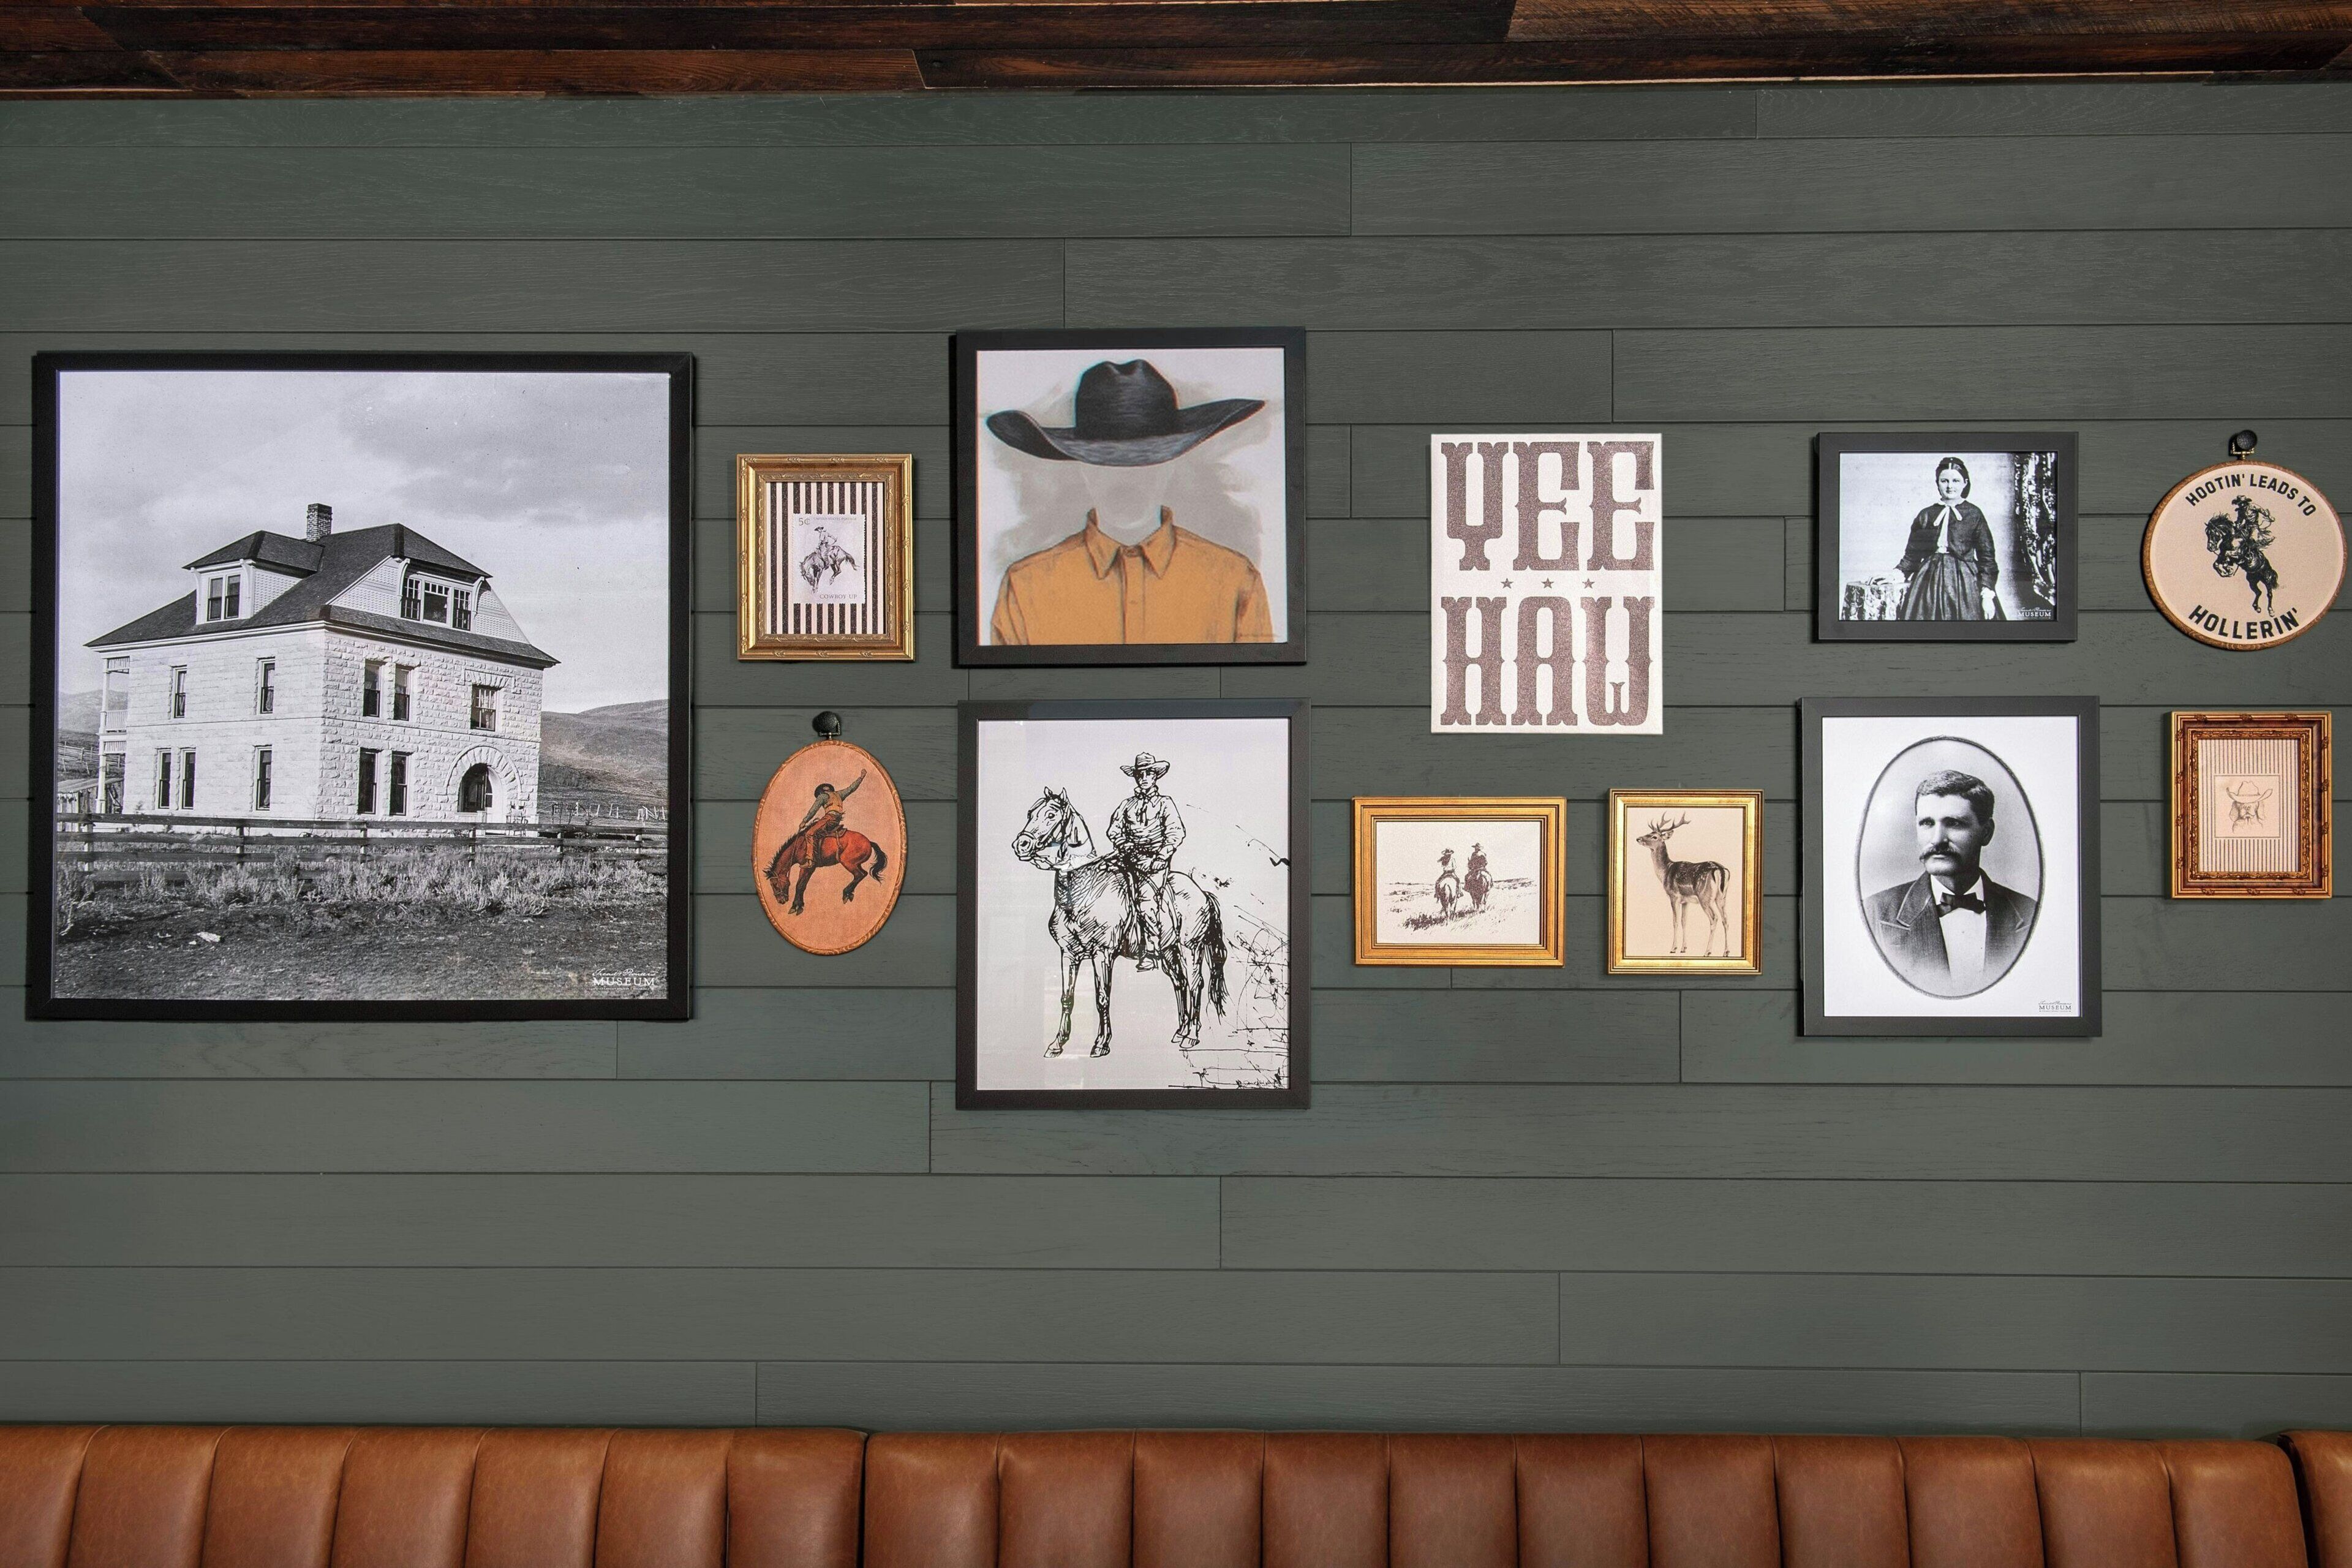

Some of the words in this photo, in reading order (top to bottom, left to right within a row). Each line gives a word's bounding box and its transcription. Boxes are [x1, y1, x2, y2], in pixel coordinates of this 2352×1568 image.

[1441, 441, 1654, 571] YEE
[2185, 473, 2245, 506] HOOTIN'
[2250, 473, 2299, 500] LEADS
[2297, 496, 2317, 517] TO
[798, 518, 810, 526] 5¢
[2188, 604, 2300, 639] HOLLERIN'
[1440, 596, 1654, 726] HAW
[593, 977, 655, 986] MUSEUM
